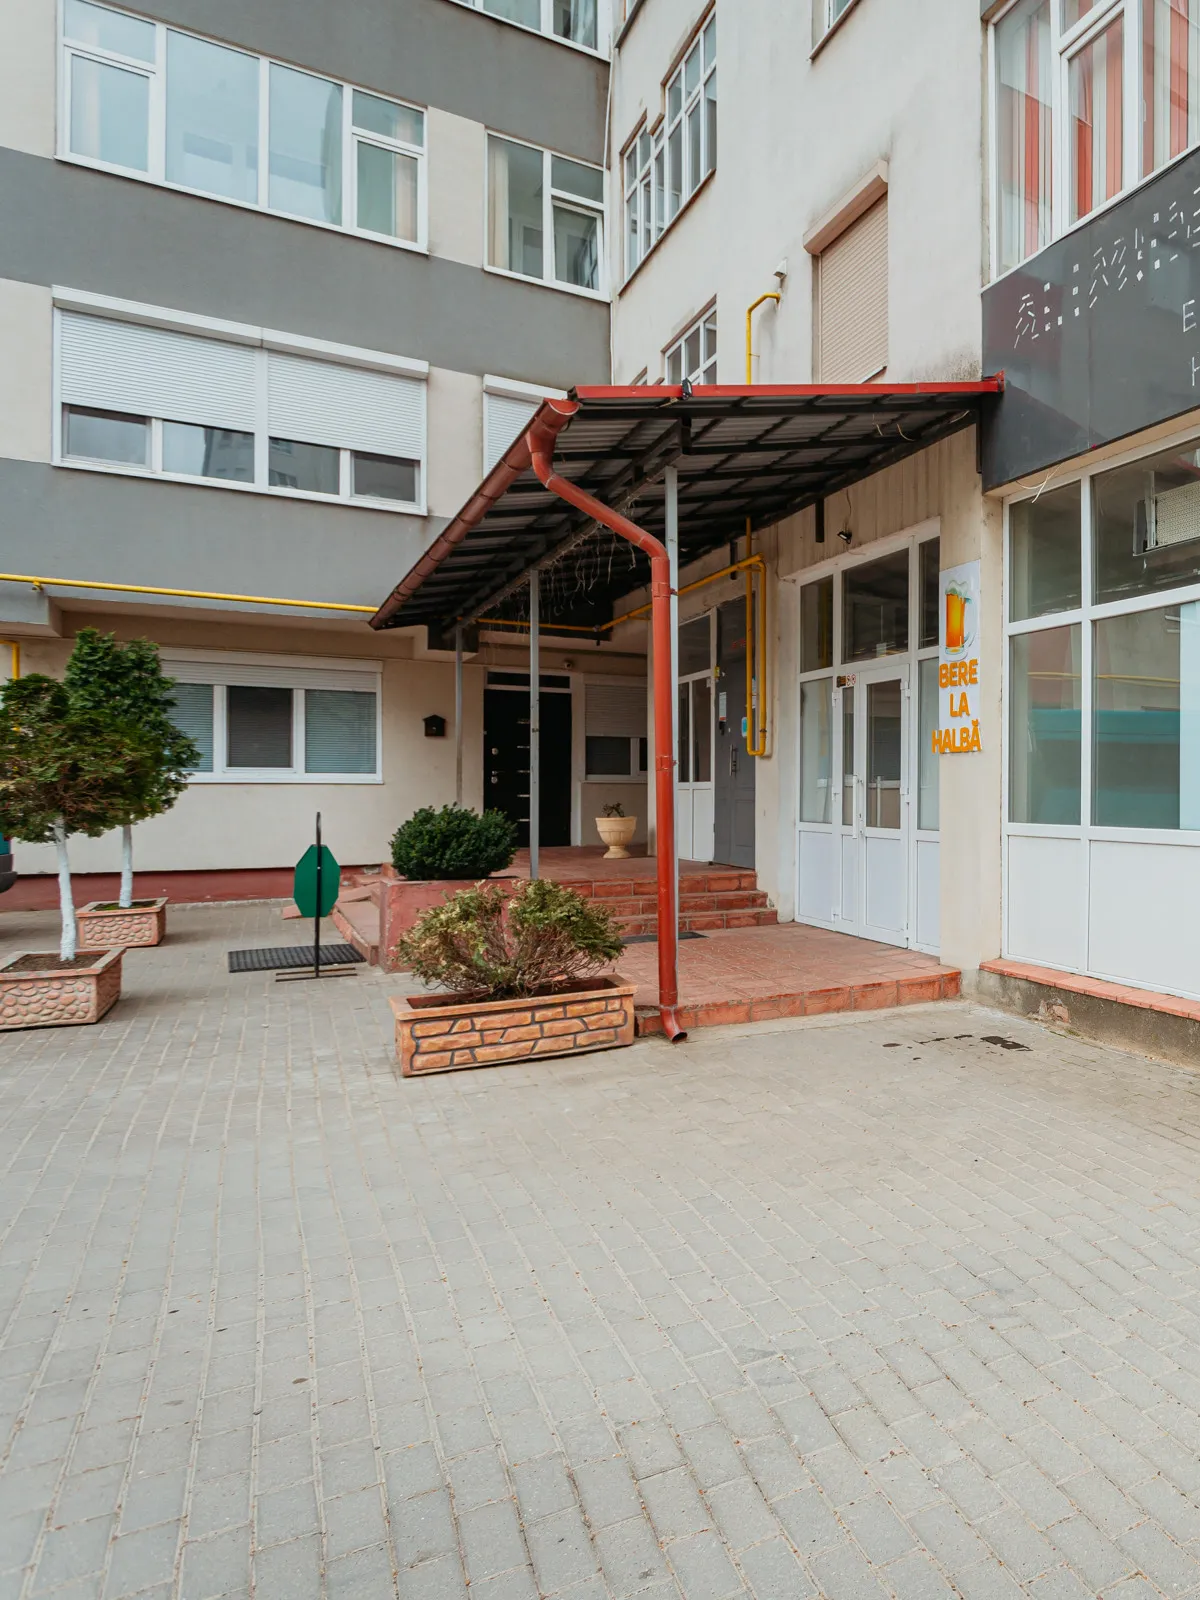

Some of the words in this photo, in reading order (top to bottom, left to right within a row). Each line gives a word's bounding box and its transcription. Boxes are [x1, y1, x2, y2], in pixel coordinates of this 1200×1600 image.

[938, 658, 978, 689] BERE
[949, 691, 970, 718] LA
[931, 718, 982, 754] HALBĂ
